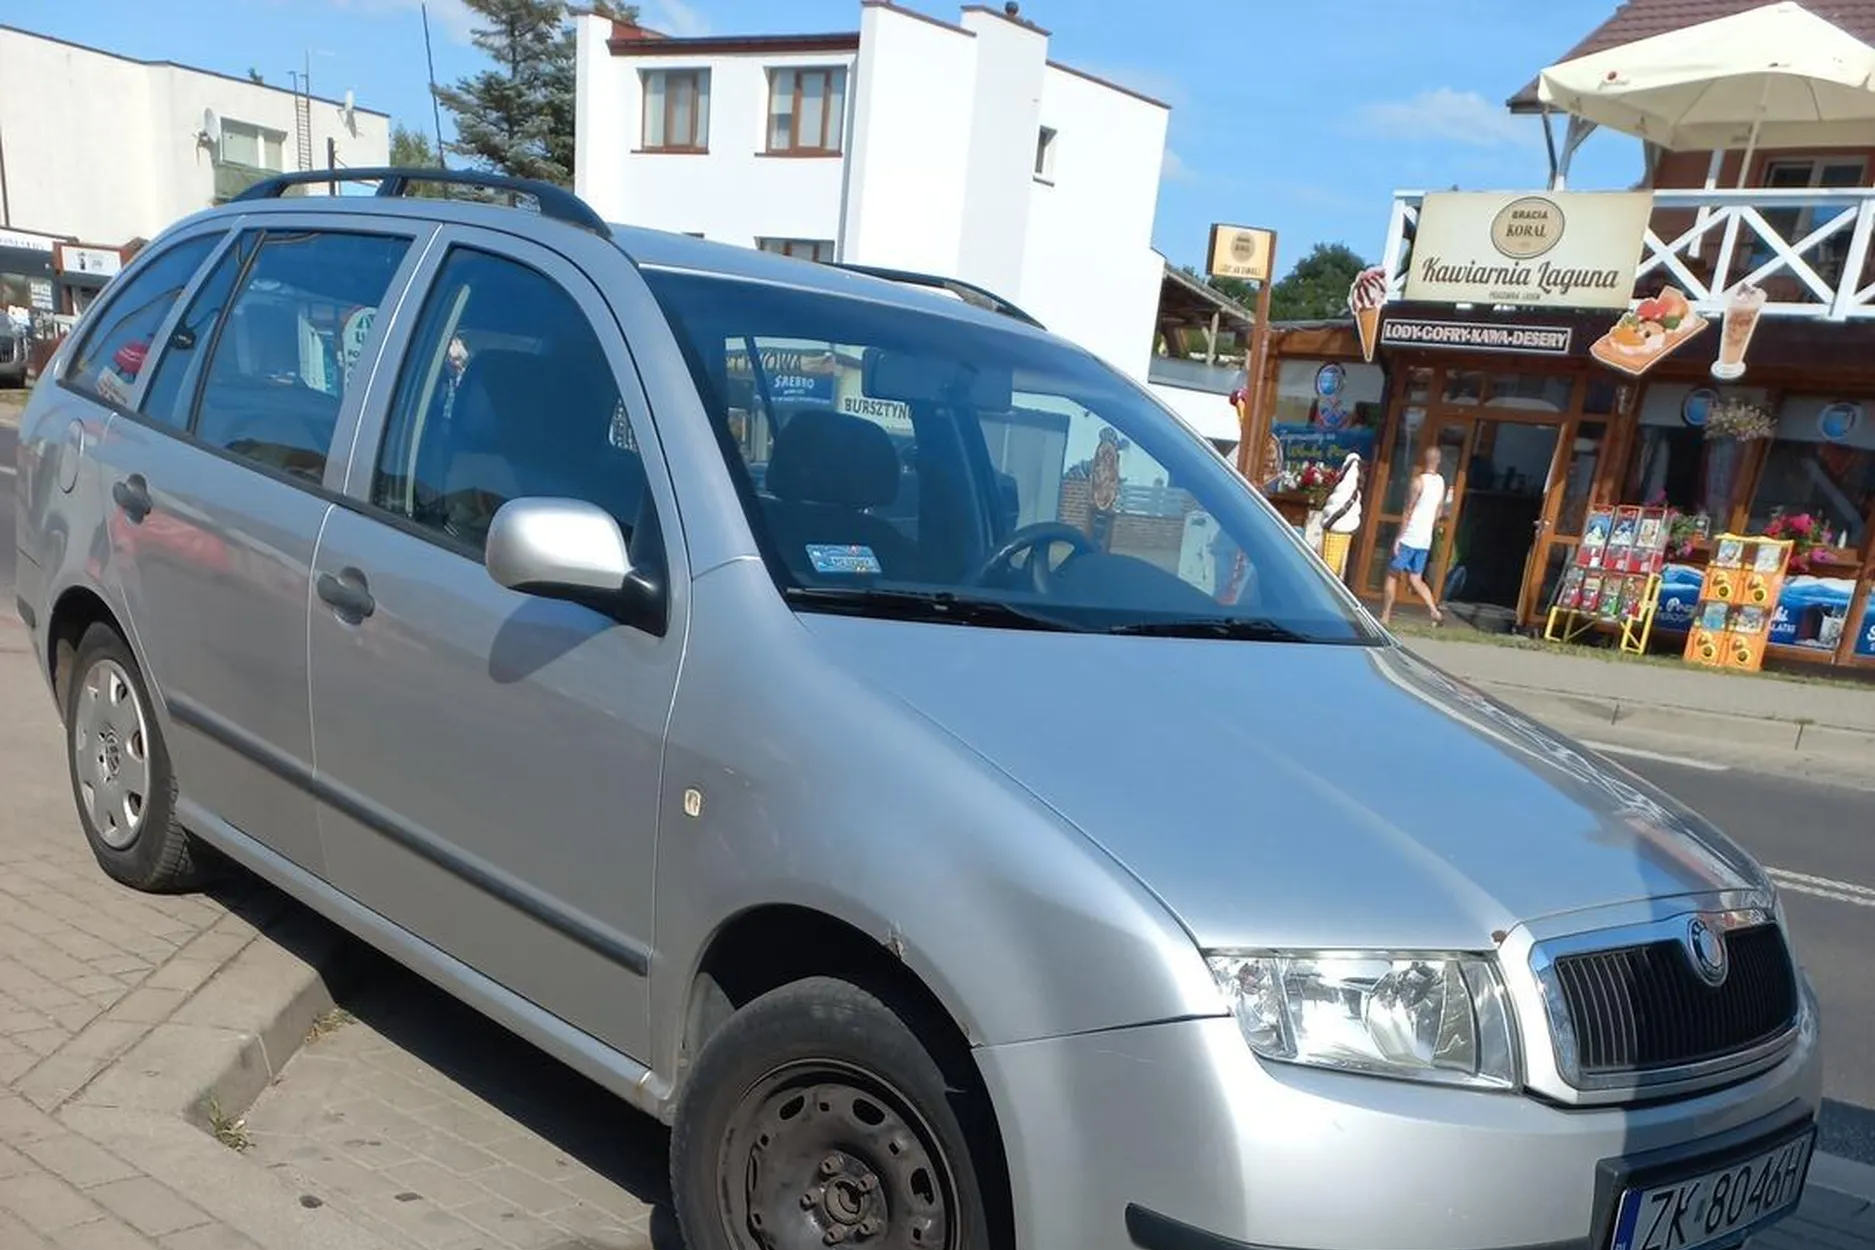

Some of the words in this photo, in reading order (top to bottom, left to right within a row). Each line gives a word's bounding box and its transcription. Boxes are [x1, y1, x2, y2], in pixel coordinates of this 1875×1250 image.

[1506, 223, 1547, 238] KORAL
[1421, 256, 1532, 286] Kawiarnia
[1537, 260, 1620, 295] Laguna
